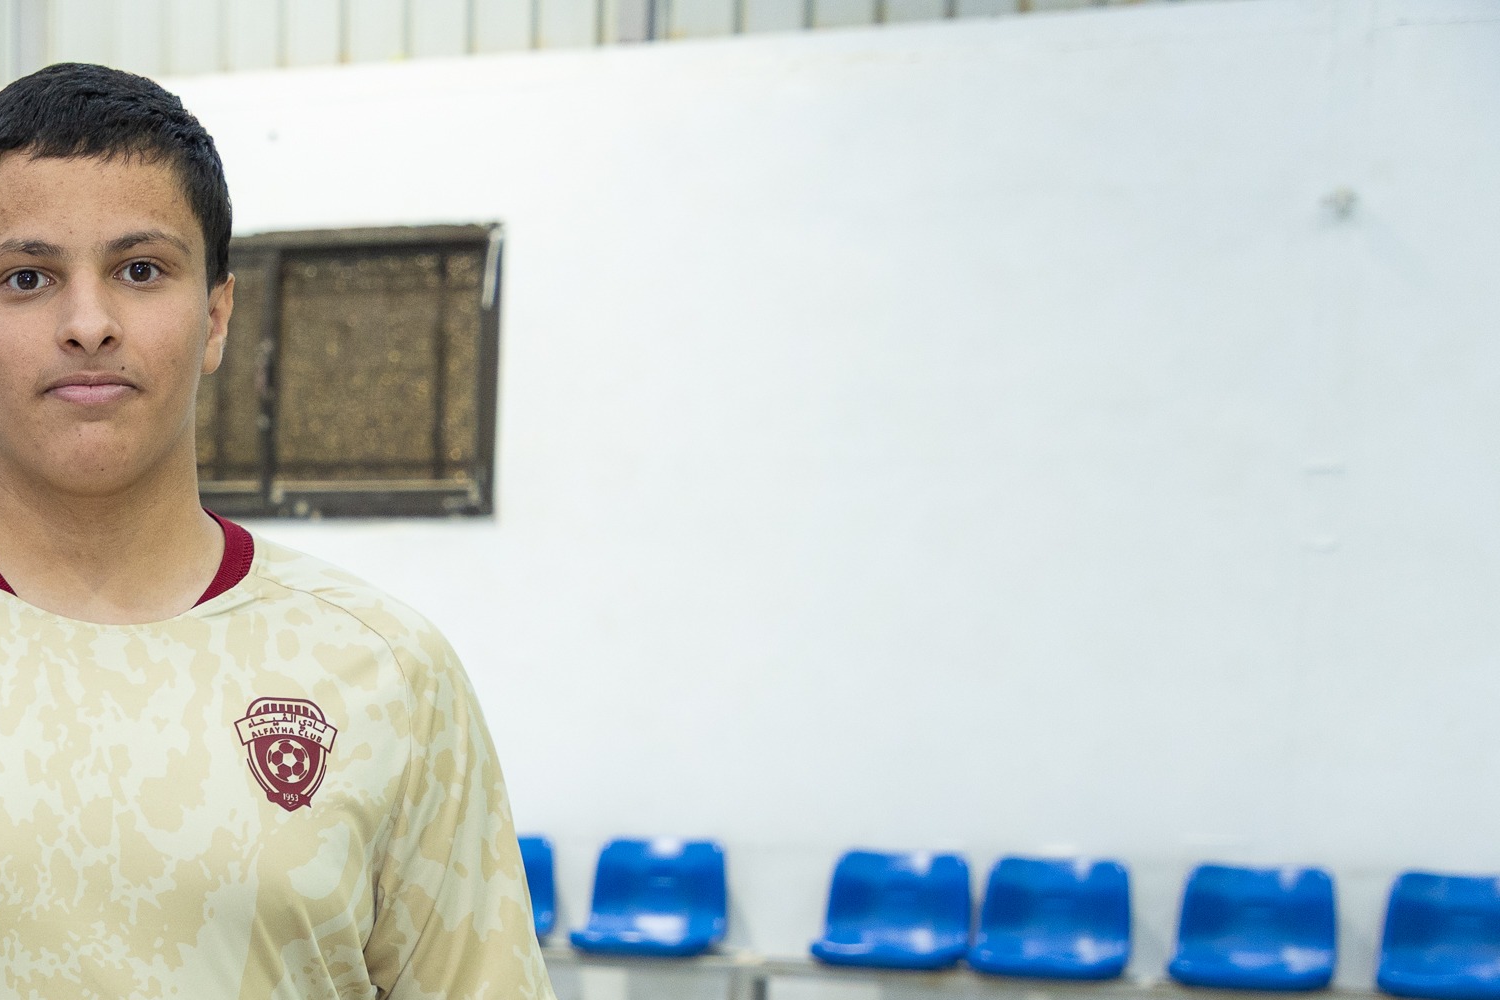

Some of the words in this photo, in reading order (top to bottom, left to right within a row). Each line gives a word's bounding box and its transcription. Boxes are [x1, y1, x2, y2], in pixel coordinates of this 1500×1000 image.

[248, 712, 297, 728] الفيحاء
[251, 726, 295, 739] ALFAYHA
[298, 729, 323, 743] CLUB
[283, 793, 299, 802] 1953
